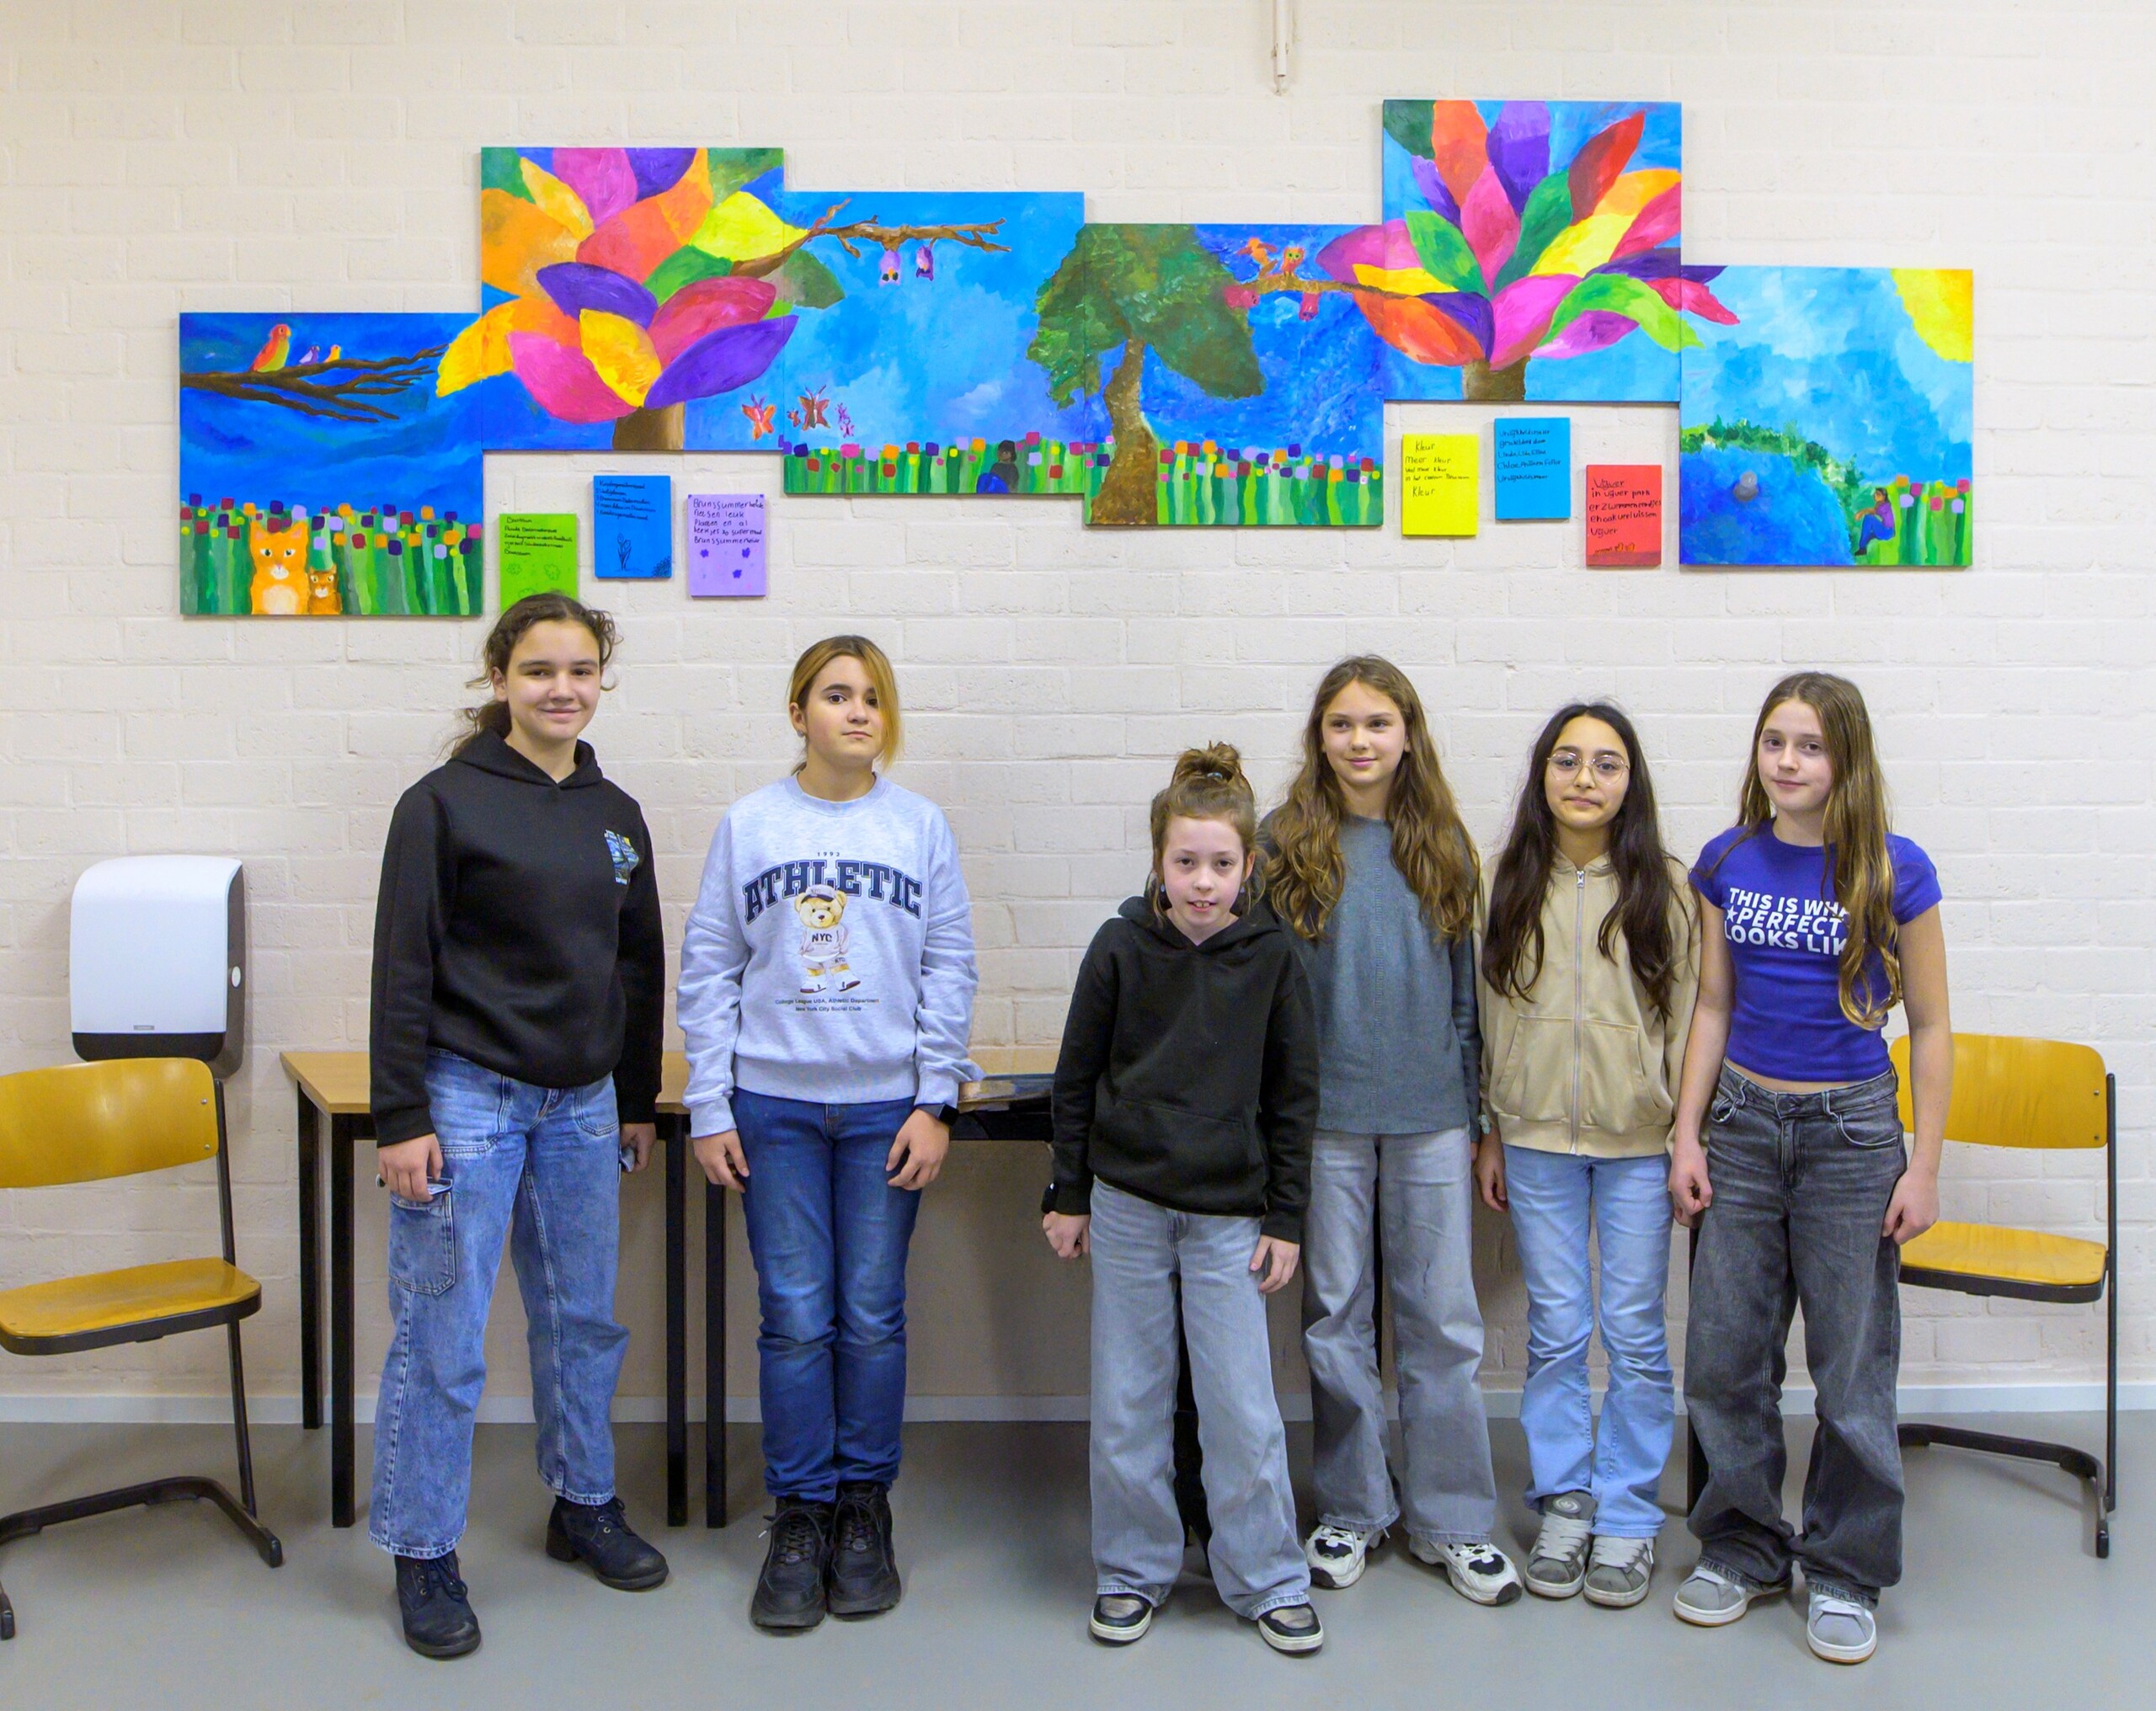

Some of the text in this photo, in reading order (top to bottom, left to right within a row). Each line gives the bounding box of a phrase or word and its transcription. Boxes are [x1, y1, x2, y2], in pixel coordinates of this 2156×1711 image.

[1416, 440, 1435, 452] Kleur
[1412, 486, 1435, 497] Kleur
[742, 859, 923, 925] ATHLETIC
[1730, 887, 1773, 909] THIS
[1777, 897, 1798, 914] IS
[1737, 907, 1844, 936] PERFECT
[812, 933, 832, 942] NYC
[1725, 920, 1848, 956] LOOKS LIK
